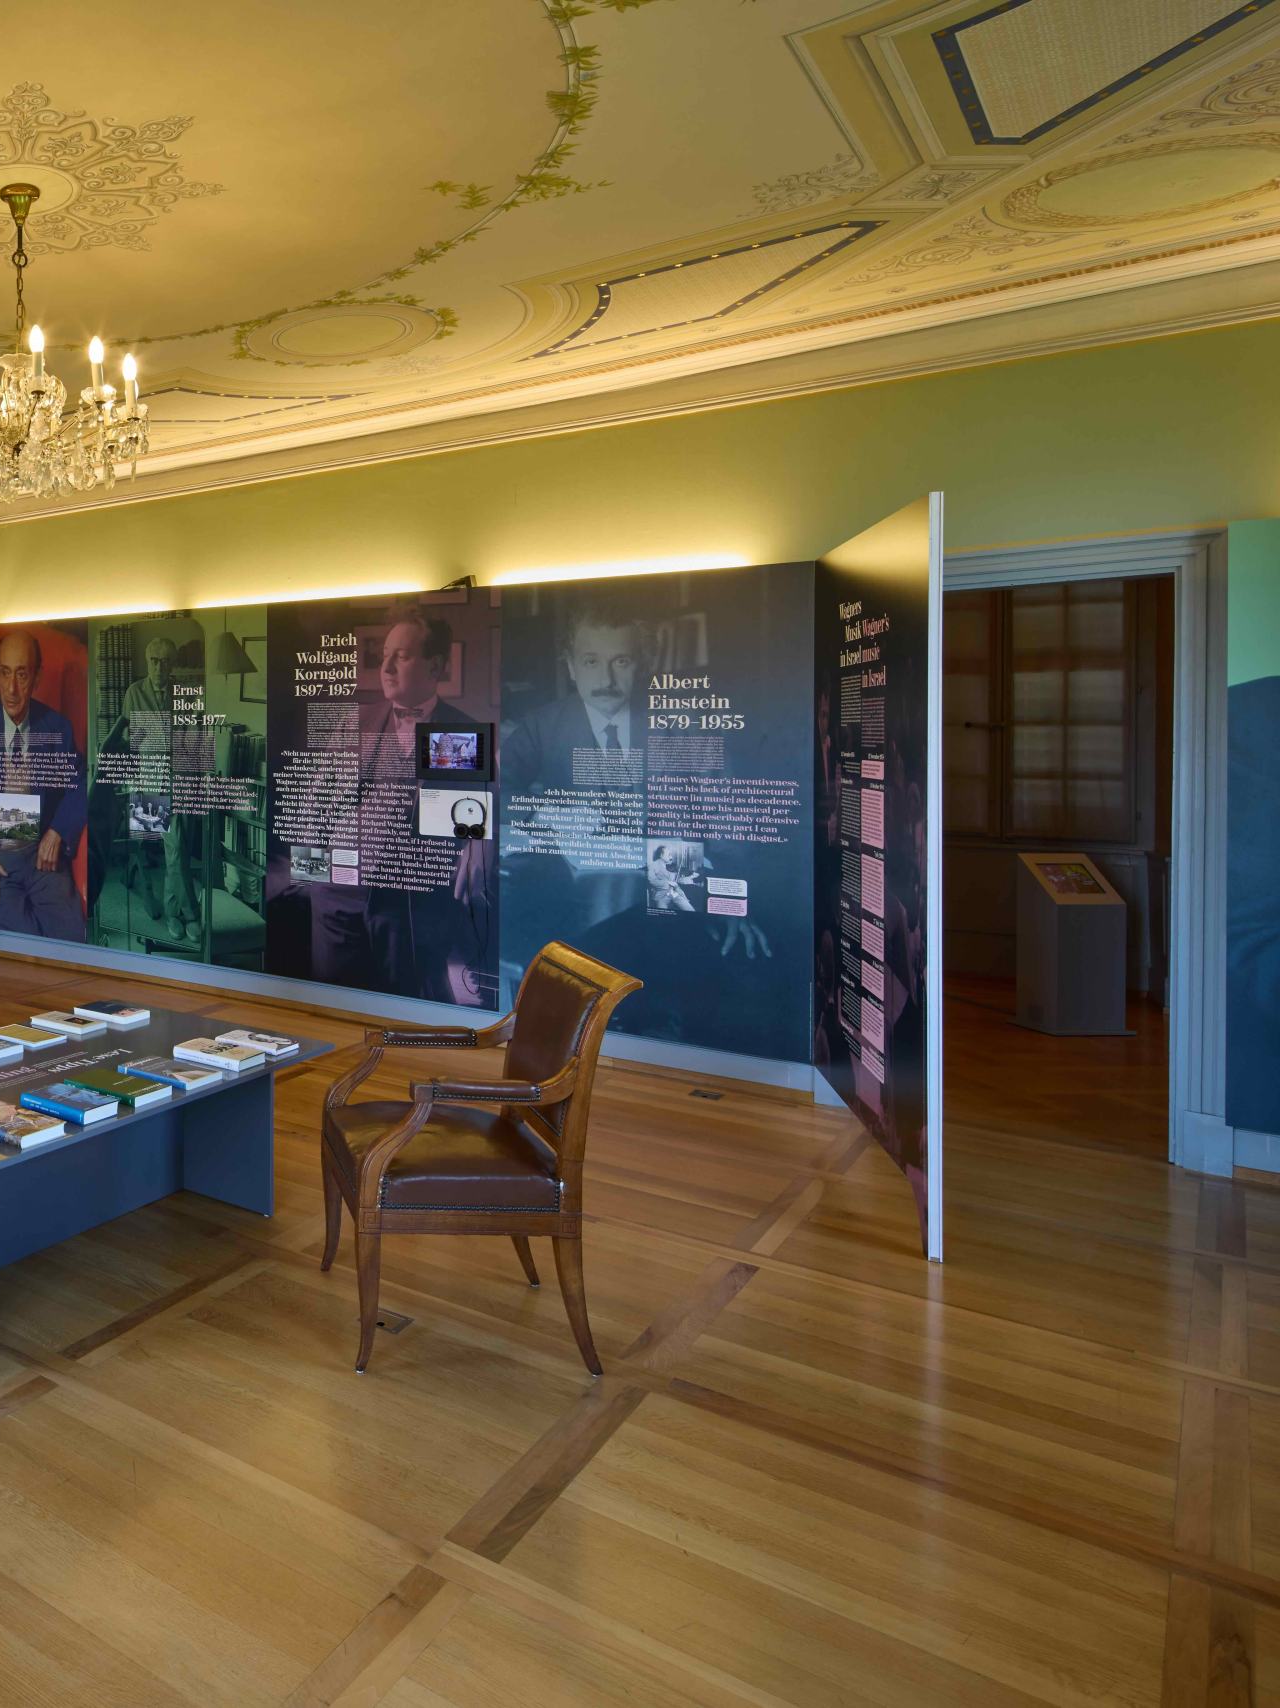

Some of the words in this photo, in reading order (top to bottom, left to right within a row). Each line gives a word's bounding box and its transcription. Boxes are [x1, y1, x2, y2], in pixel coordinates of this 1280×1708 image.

[840, 601, 861, 622] Wagners
[845, 621, 861, 642] Musik
[862, 612, 889, 640] Wagner's
[321, 633, 357, 647] Erich
[296, 651, 357, 666] Wolfgang
[840, 651, 845, 667] in
[846, 644, 861, 666] Israel
[862, 642, 880, 663] music
[294, 666, 357, 682] Korngold
[862, 670, 868, 688] in
[869, 665, 886, 687] Israel
[648, 674, 710, 689] Albert
[173, 685, 203, 695] Ernst
[295, 684, 357, 696] 1897–1957
[173, 699, 204, 710] Bloch
[648, 694, 731, 709] Einstein
[173, 714, 226, 725] 1885–1977
[648, 714, 745, 729] 1879–1955
[561, 789, 606, 798] bewundere
[608, 791, 643, 800] Wagners
[648, 793, 688, 801] structure
[700, 785, 719, 793] lack
[721, 786, 730, 794] of
[732, 787, 794, 796] architectural
[591, 799, 609, 807] aber
[610, 799, 622, 807] ich
[624, 800, 643, 808] sehe
[718, 804, 732, 812] his
[734, 805, 770, 814] musical
[647, 811, 680, 820] sonality
[692, 812, 753, 824] indescribably
[756, 816, 799, 825] offensive
[659, 820, 676, 828] that
[733, 824, 752, 832] part
[647, 828, 671, 836] listen
[684, 830, 701, 838] him
[703, 831, 722, 840] only
[725, 832, 745, 840] with
